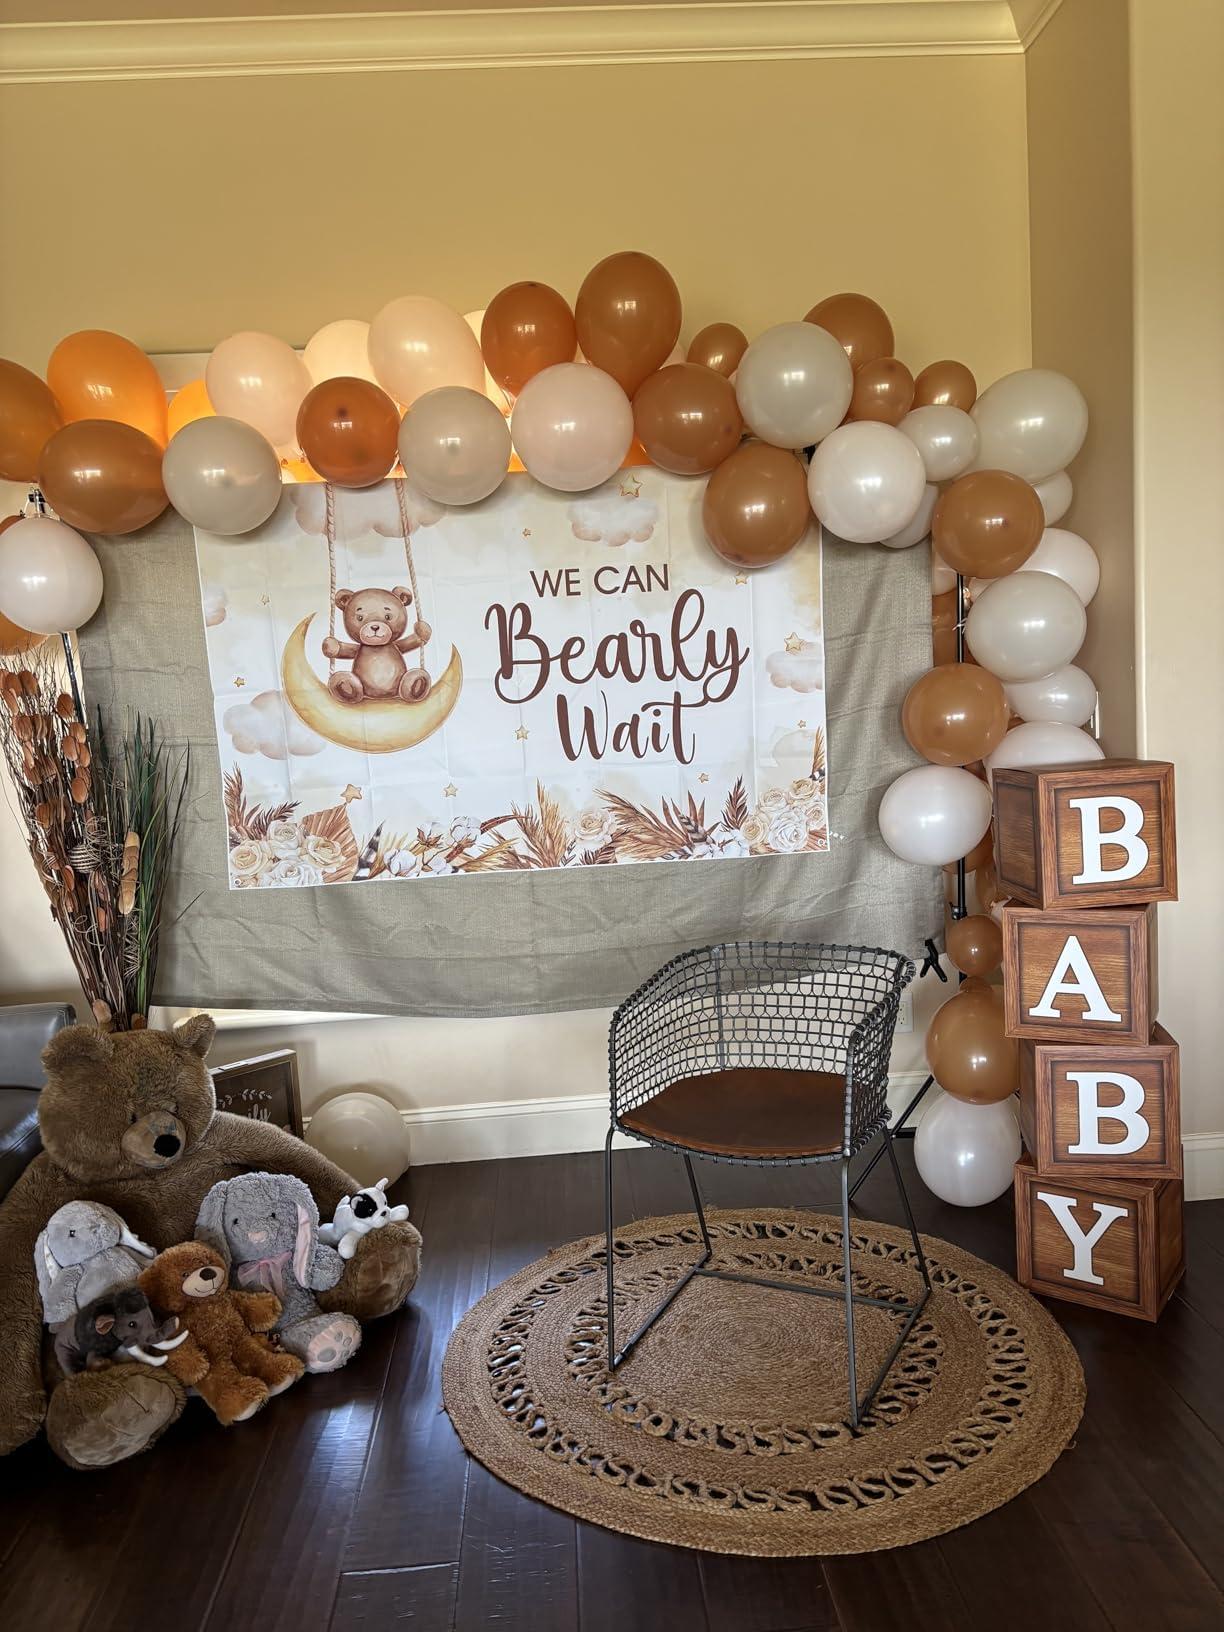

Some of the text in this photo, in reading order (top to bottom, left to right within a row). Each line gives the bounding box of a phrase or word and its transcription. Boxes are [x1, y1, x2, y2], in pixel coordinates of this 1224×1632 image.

[529, 563, 669, 598] WE CAN
[484, 588, 750, 704] Bearly
[556, 690, 708, 765] Wait
